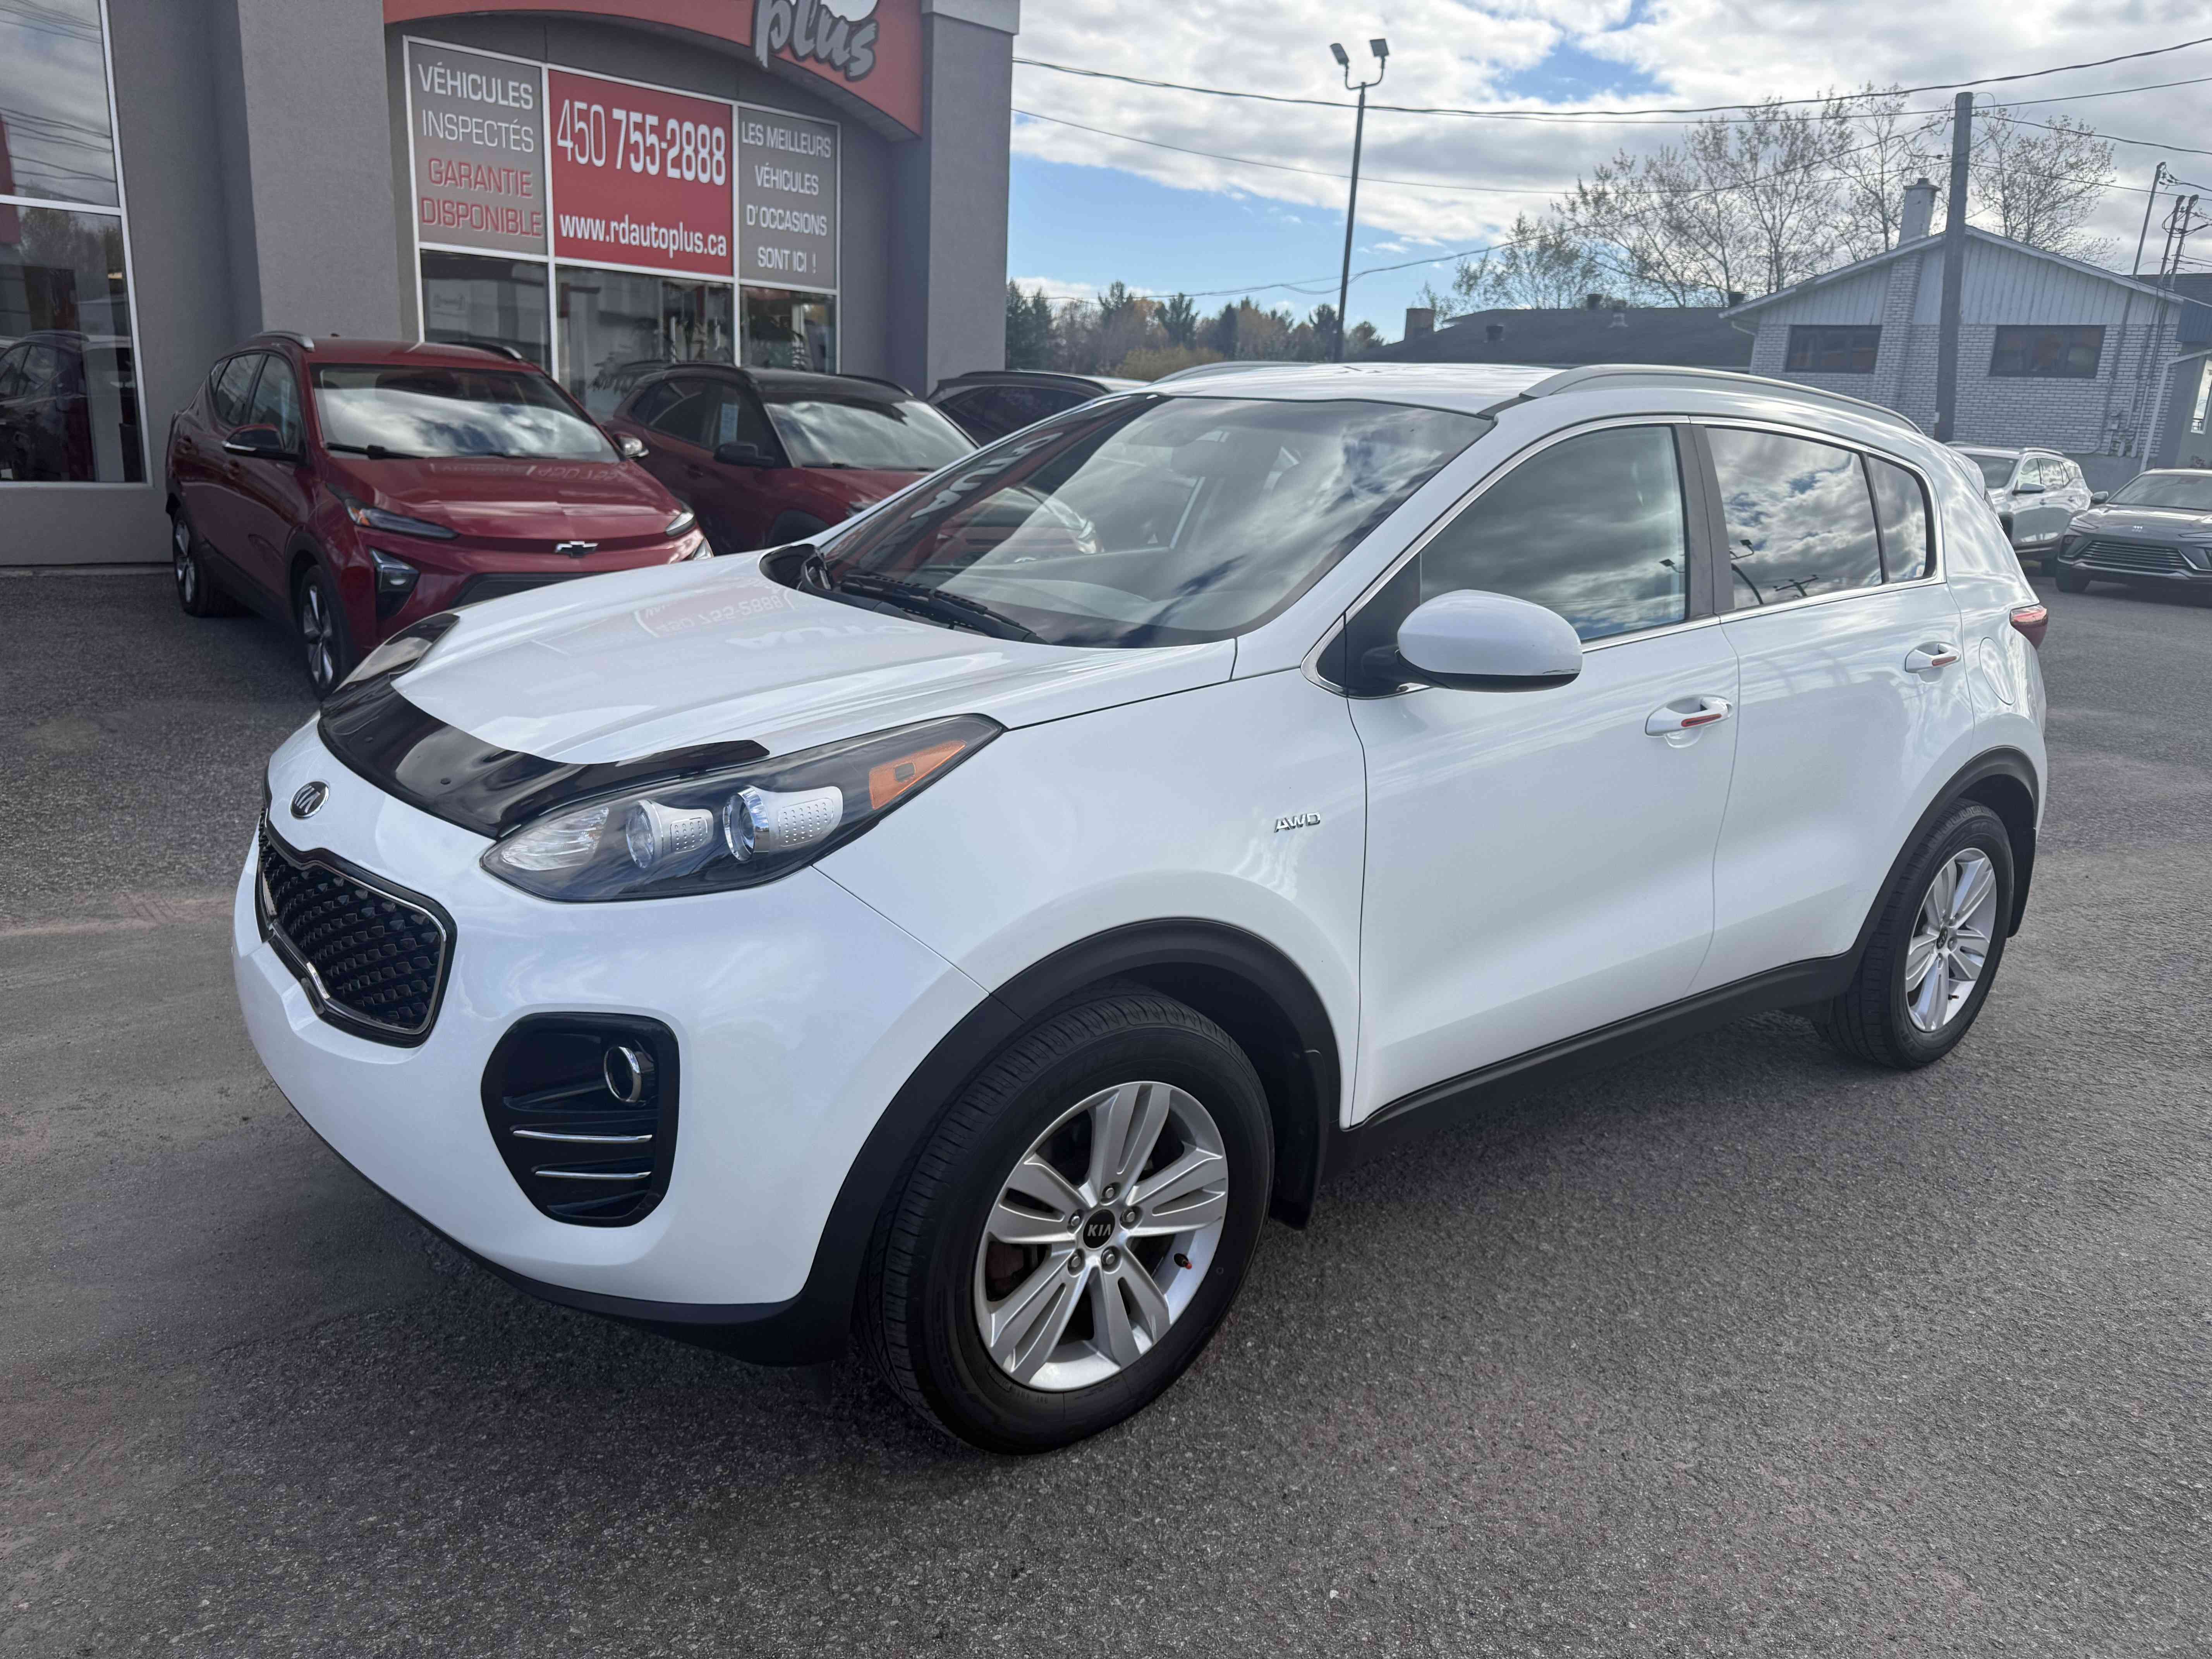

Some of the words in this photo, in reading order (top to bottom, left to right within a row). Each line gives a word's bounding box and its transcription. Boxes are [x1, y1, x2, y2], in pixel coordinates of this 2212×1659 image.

[754, 0, 878, 80] plus
[418, 62, 533, 110] VÉHICULES
[422, 109, 534, 153] INSPECTÉS
[557, 99, 606, 167] 450
[612, 107, 726, 186] 755-2888
[742, 121, 764, 146] LES
[766, 125, 831, 158] MEILLEURS
[428, 158, 533, 199] GARANTIE
[754, 163, 819, 196] VÉHICULES
[421, 197, 543, 238] DISPONIBLE
[559, 214, 726, 259] www.rdautoplus.ca
[757, 246, 790, 271] SONT
[793, 251, 807, 272] ICI
[1274, 812, 1321, 833] AWD
[1087, 1224, 1111, 1237] KIA
